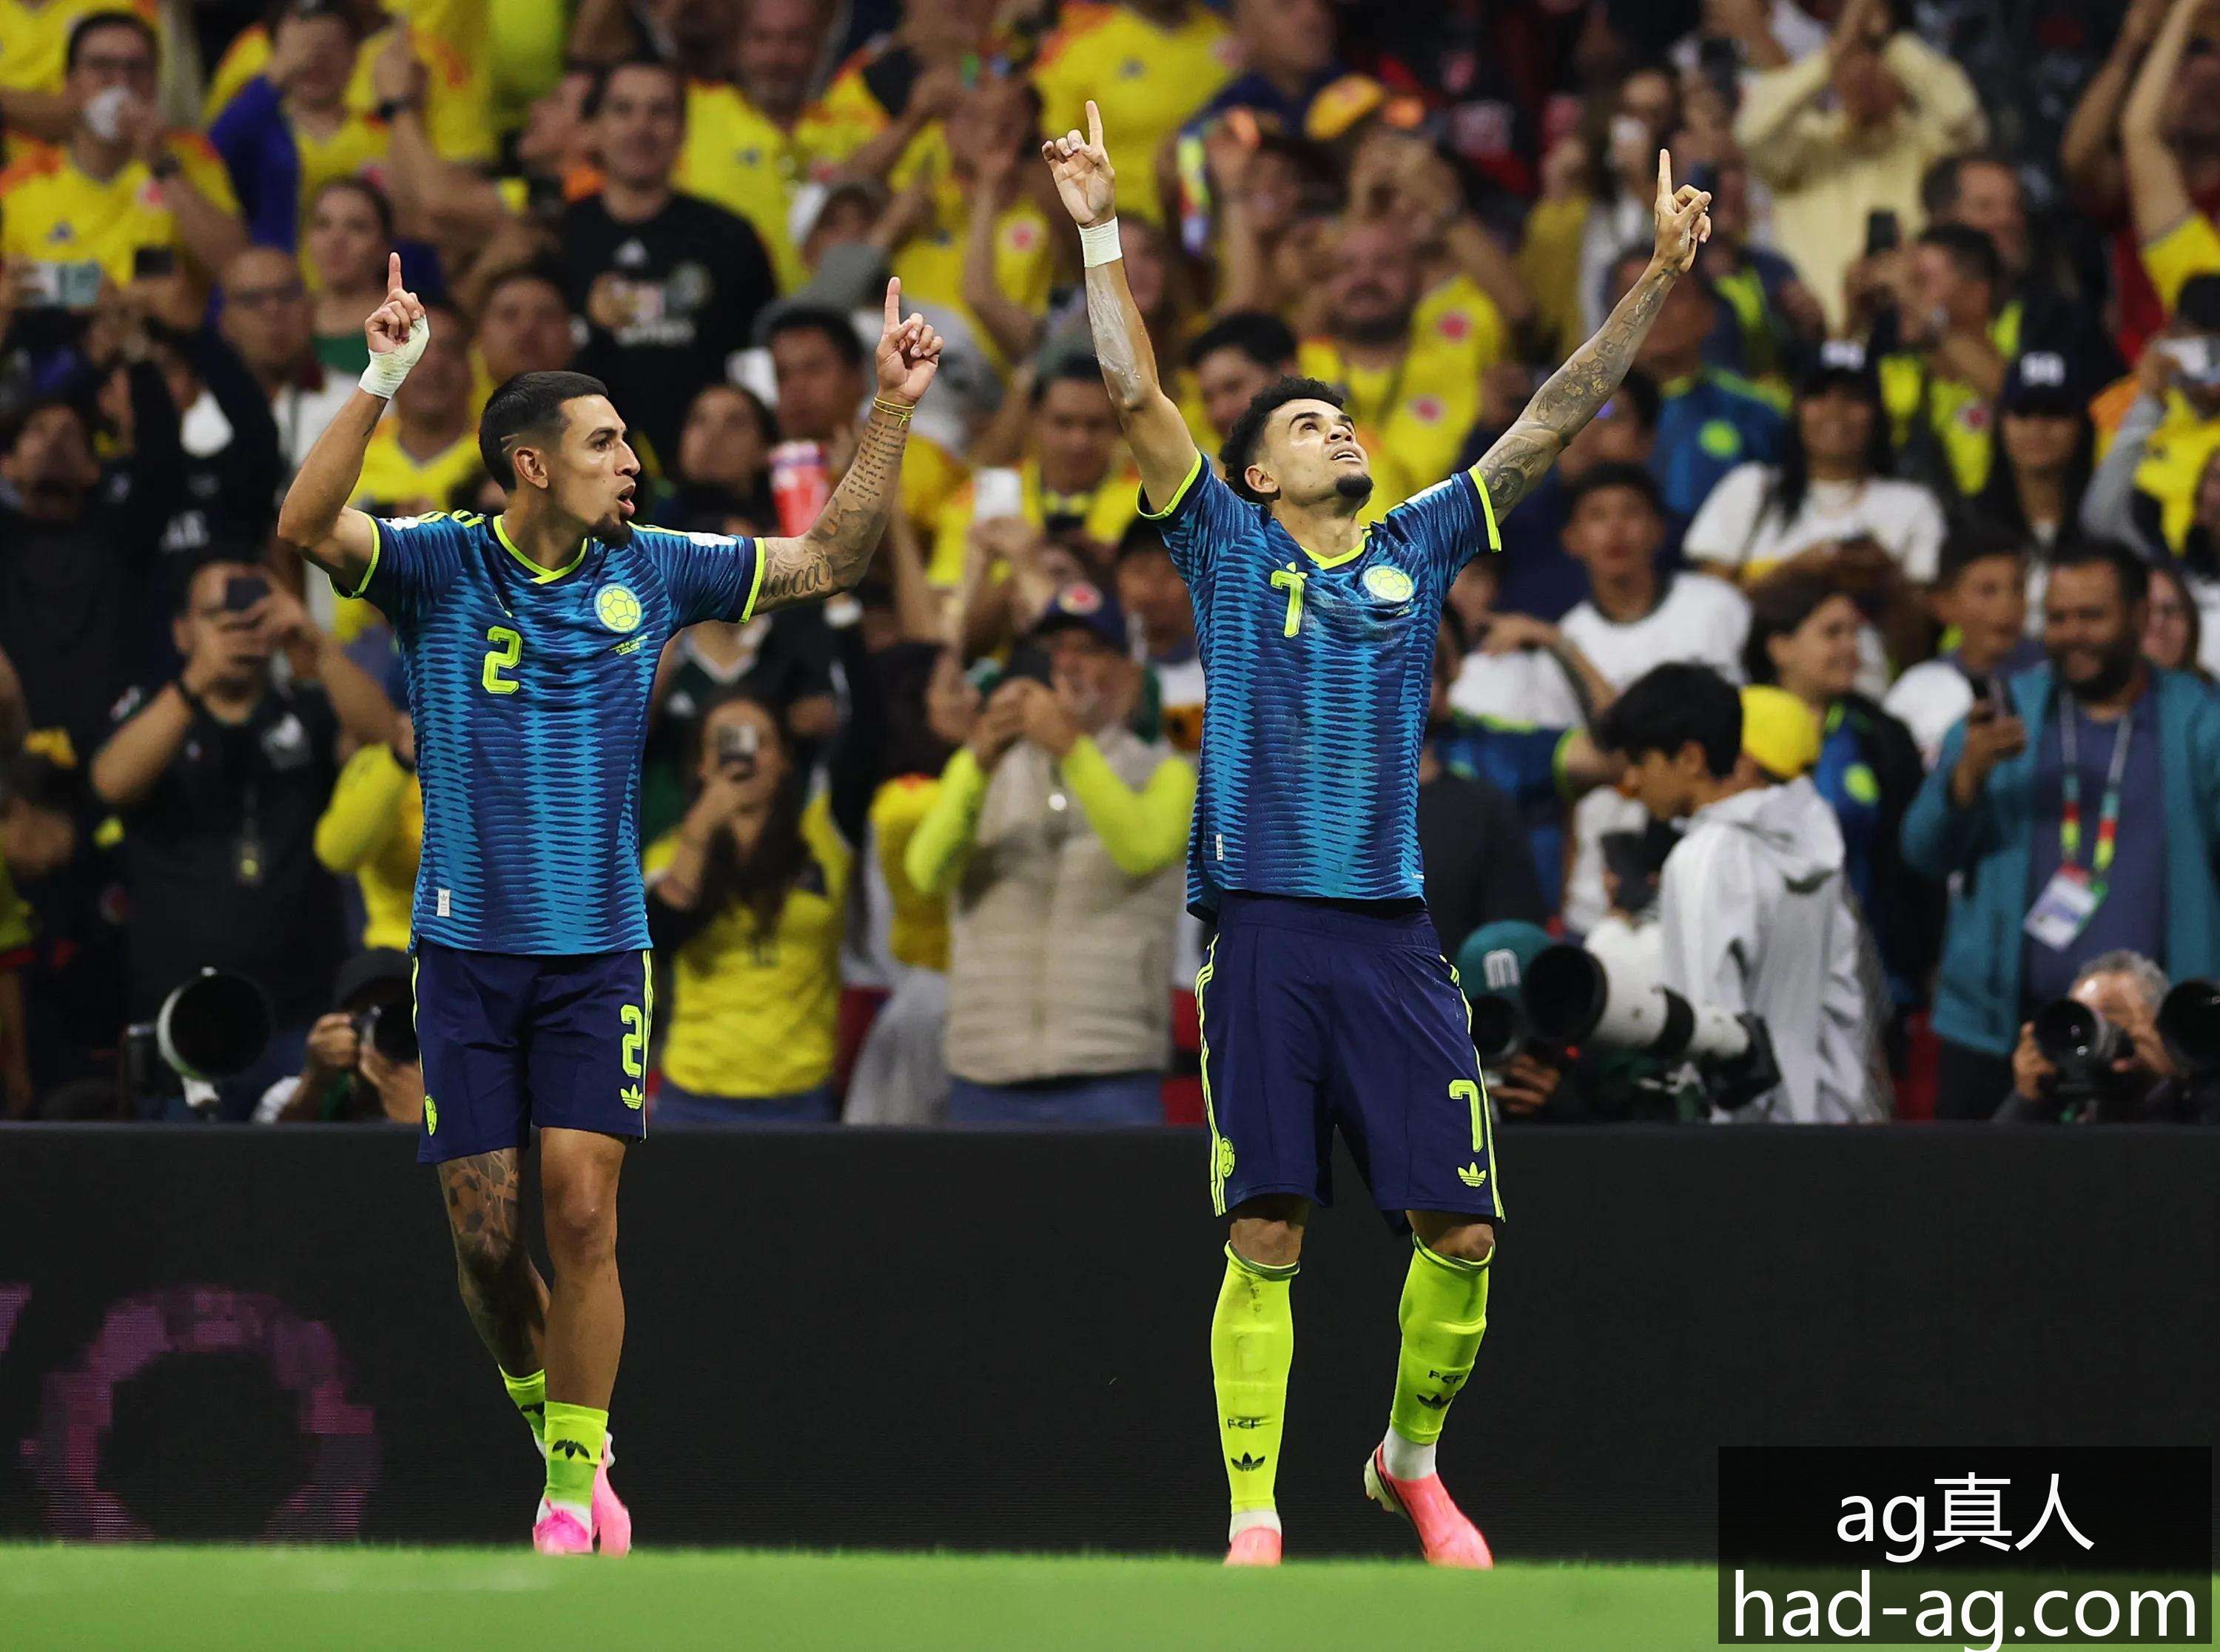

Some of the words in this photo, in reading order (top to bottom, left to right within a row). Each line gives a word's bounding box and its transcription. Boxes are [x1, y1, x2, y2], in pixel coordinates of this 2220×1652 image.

[1270, 570, 1305, 638] 7
[482, 625, 522, 695] 2
[620, 1004, 643, 1079] 2
[1448, 1079, 1484, 1153] 7
[1428, 1369, 1464, 1384] FCF
